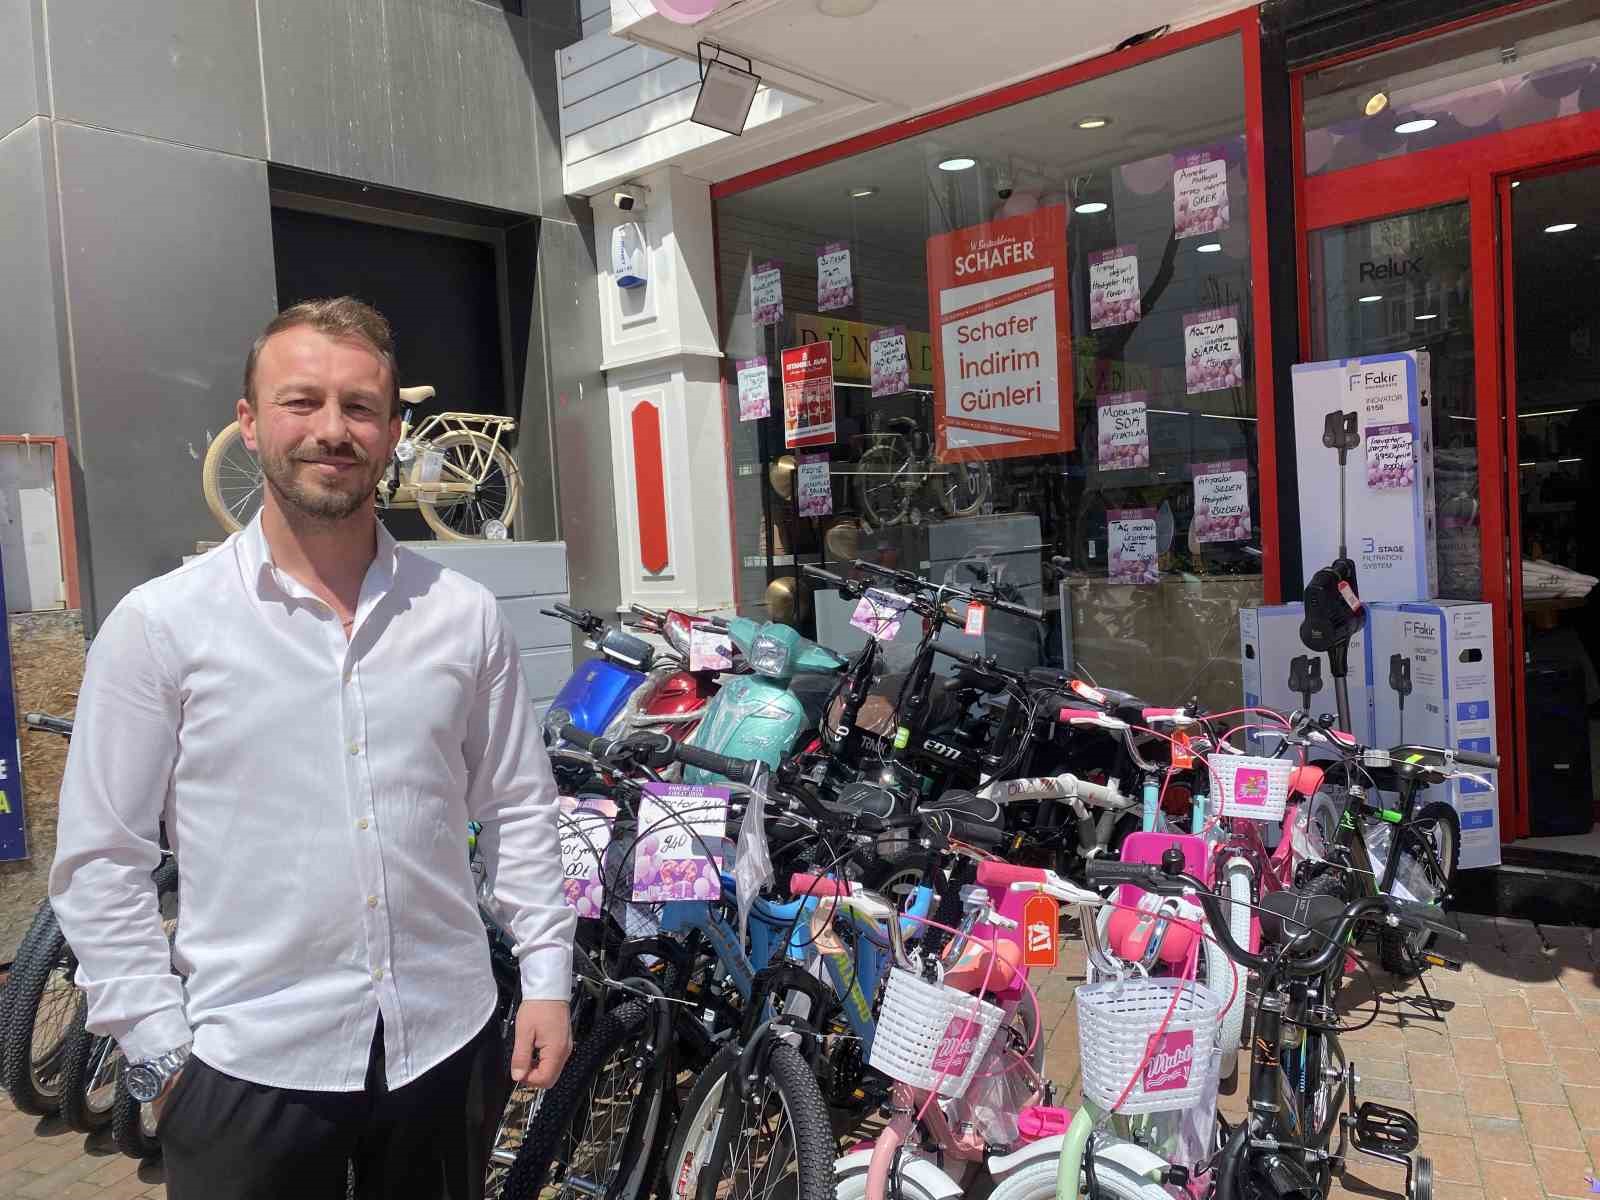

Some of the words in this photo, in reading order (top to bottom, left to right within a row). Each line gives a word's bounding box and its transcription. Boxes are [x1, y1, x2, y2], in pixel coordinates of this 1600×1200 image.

[1360, 256, 1424, 283] Relux
[957, 316, 1038, 344] Schafer
[959, 349, 1040, 380] İndirim
[1365, 371, 1398, 384] Fakir
[960, 380, 1041, 412] Günleri
[1362, 537, 1374, 553] 3
[1413, 621, 1436, 635] Fakir
